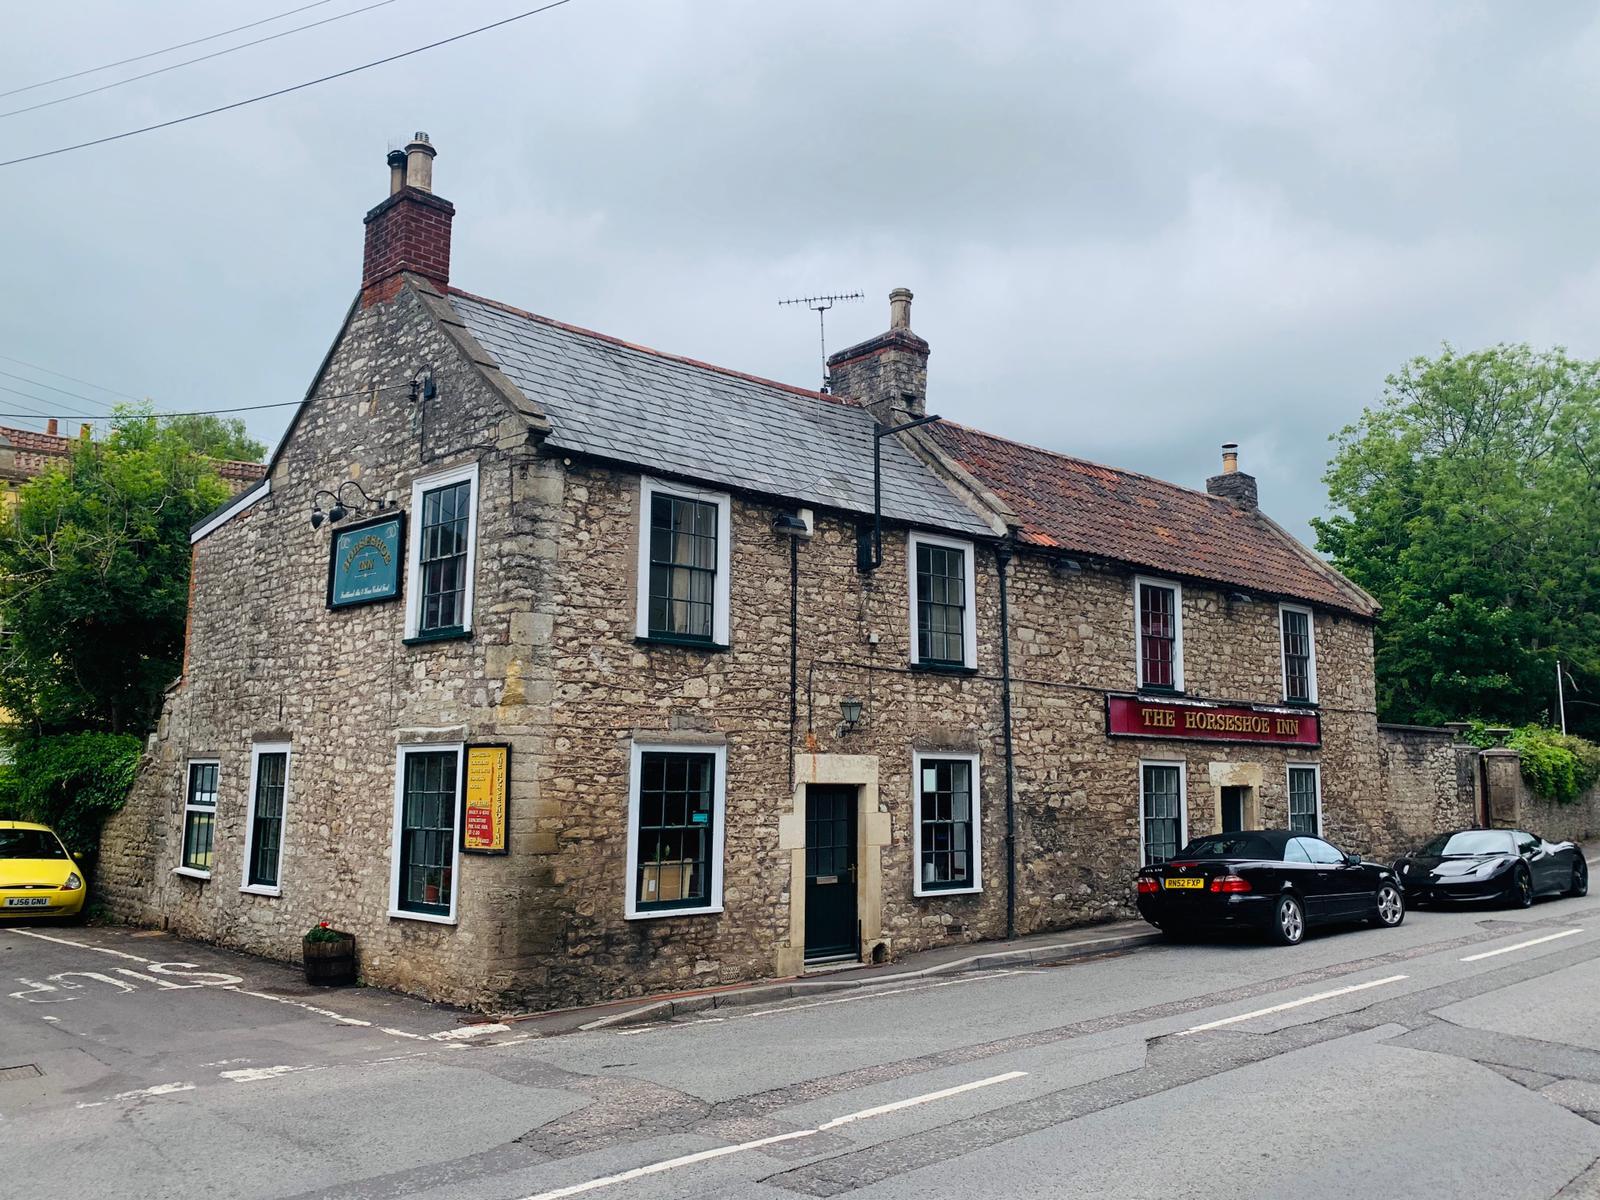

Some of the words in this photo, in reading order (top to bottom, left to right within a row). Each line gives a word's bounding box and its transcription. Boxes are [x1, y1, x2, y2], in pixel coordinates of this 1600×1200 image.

[1142, 709, 1176, 727] THE
[1185, 711, 1270, 733] HORSESHOE
[1276, 718, 1299, 735] INN
[1168, 880, 1186, 888] RN52
[8, 898, 30, 906] WJ56
